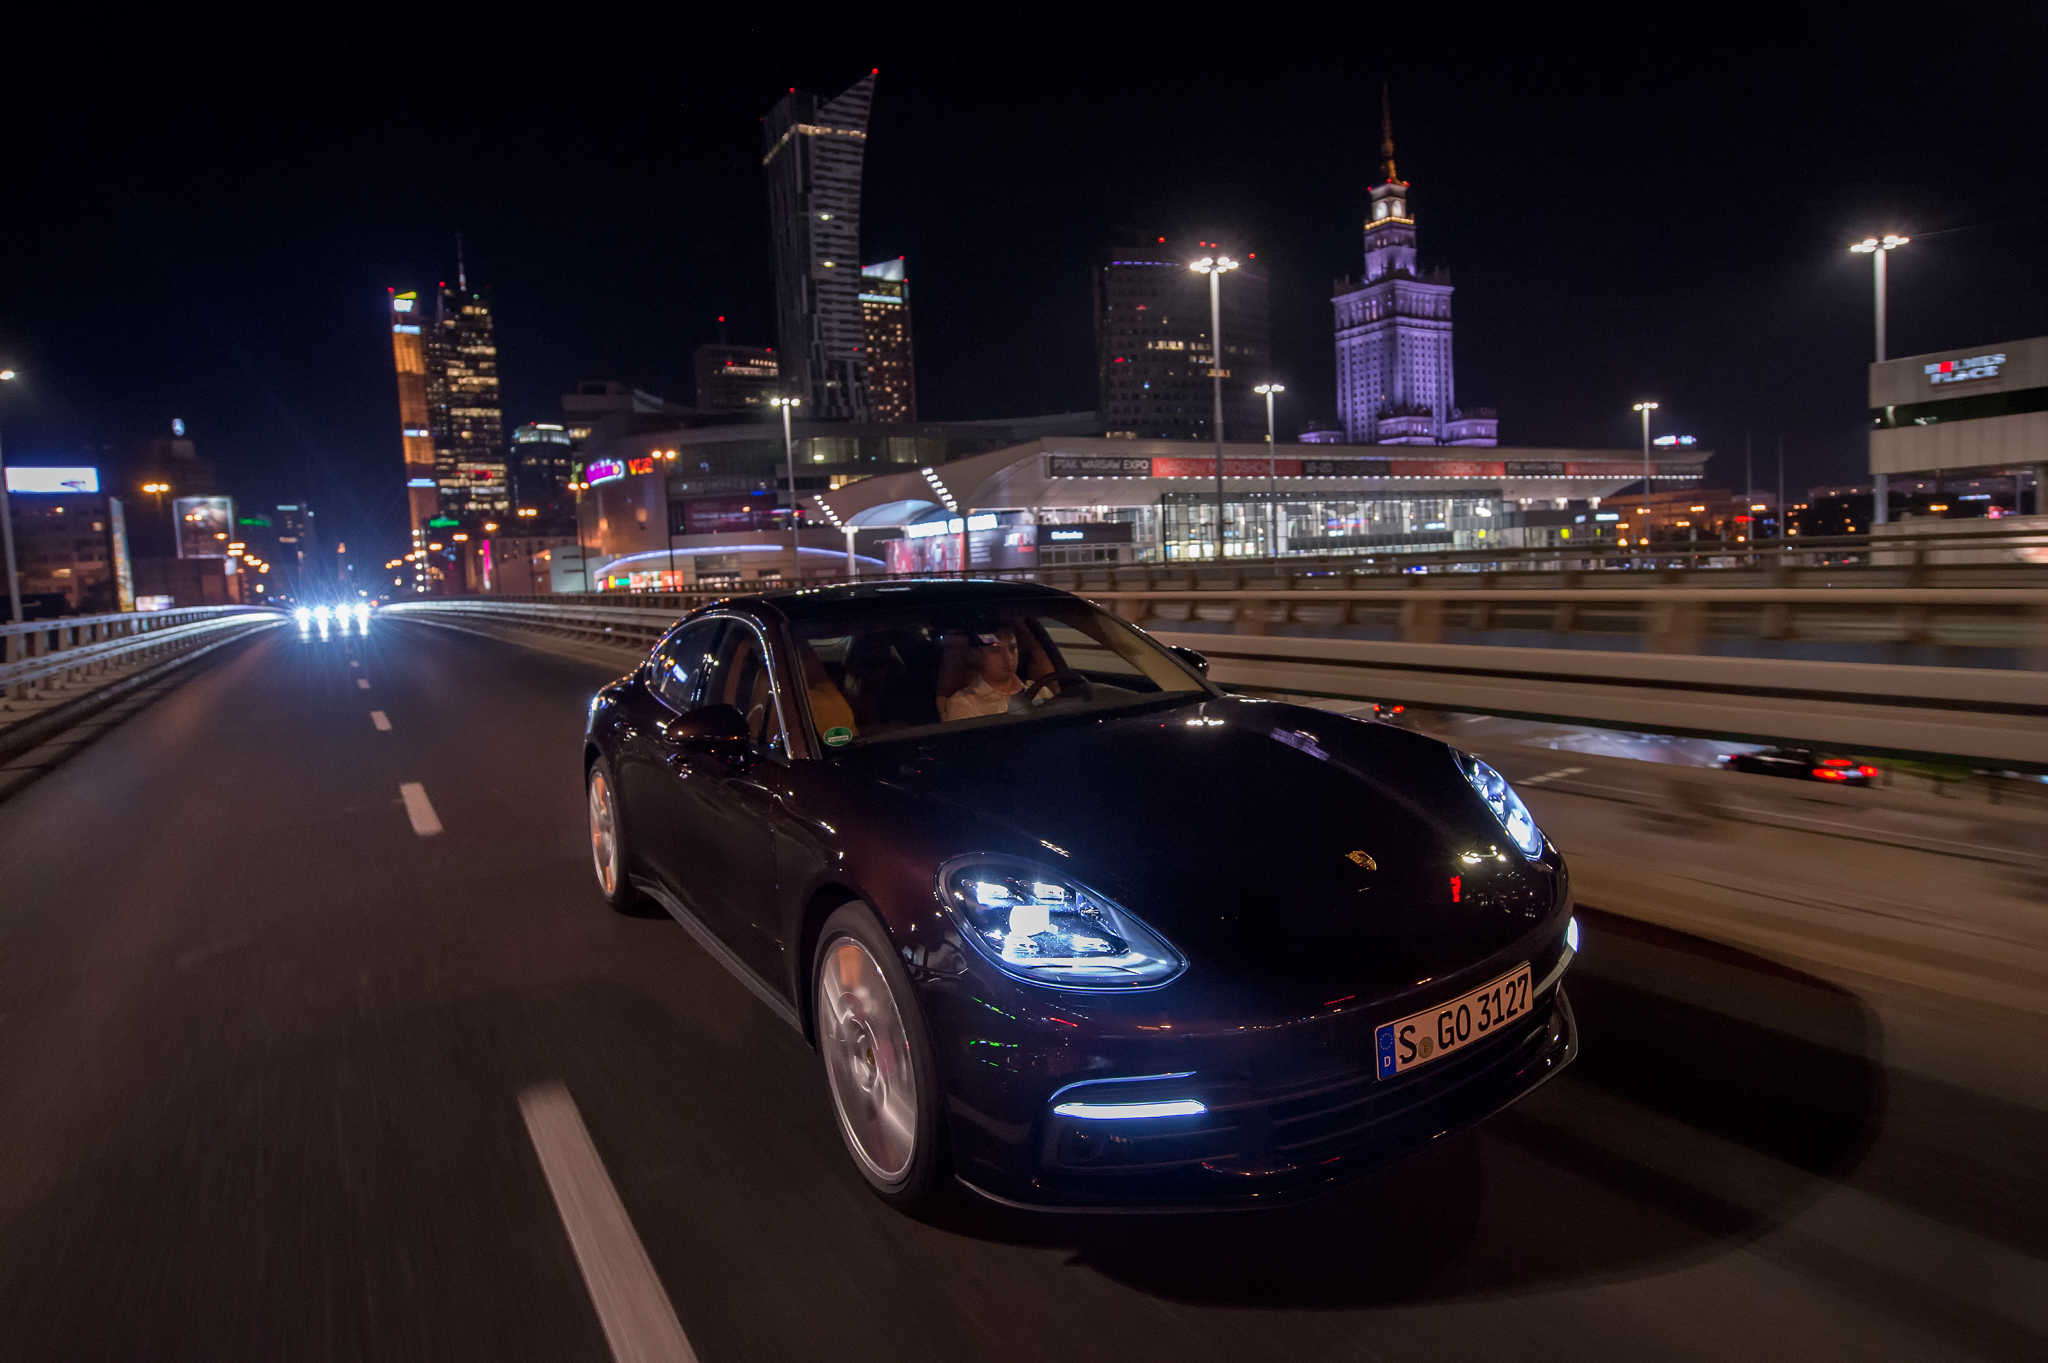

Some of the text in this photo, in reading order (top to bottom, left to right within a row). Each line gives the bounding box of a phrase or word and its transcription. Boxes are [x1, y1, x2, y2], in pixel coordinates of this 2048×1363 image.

[1123, 459, 1149, 471] EXPO
[1399, 974, 1529, 1064] S GO 3127
[1383, 1055, 1392, 1068] D
